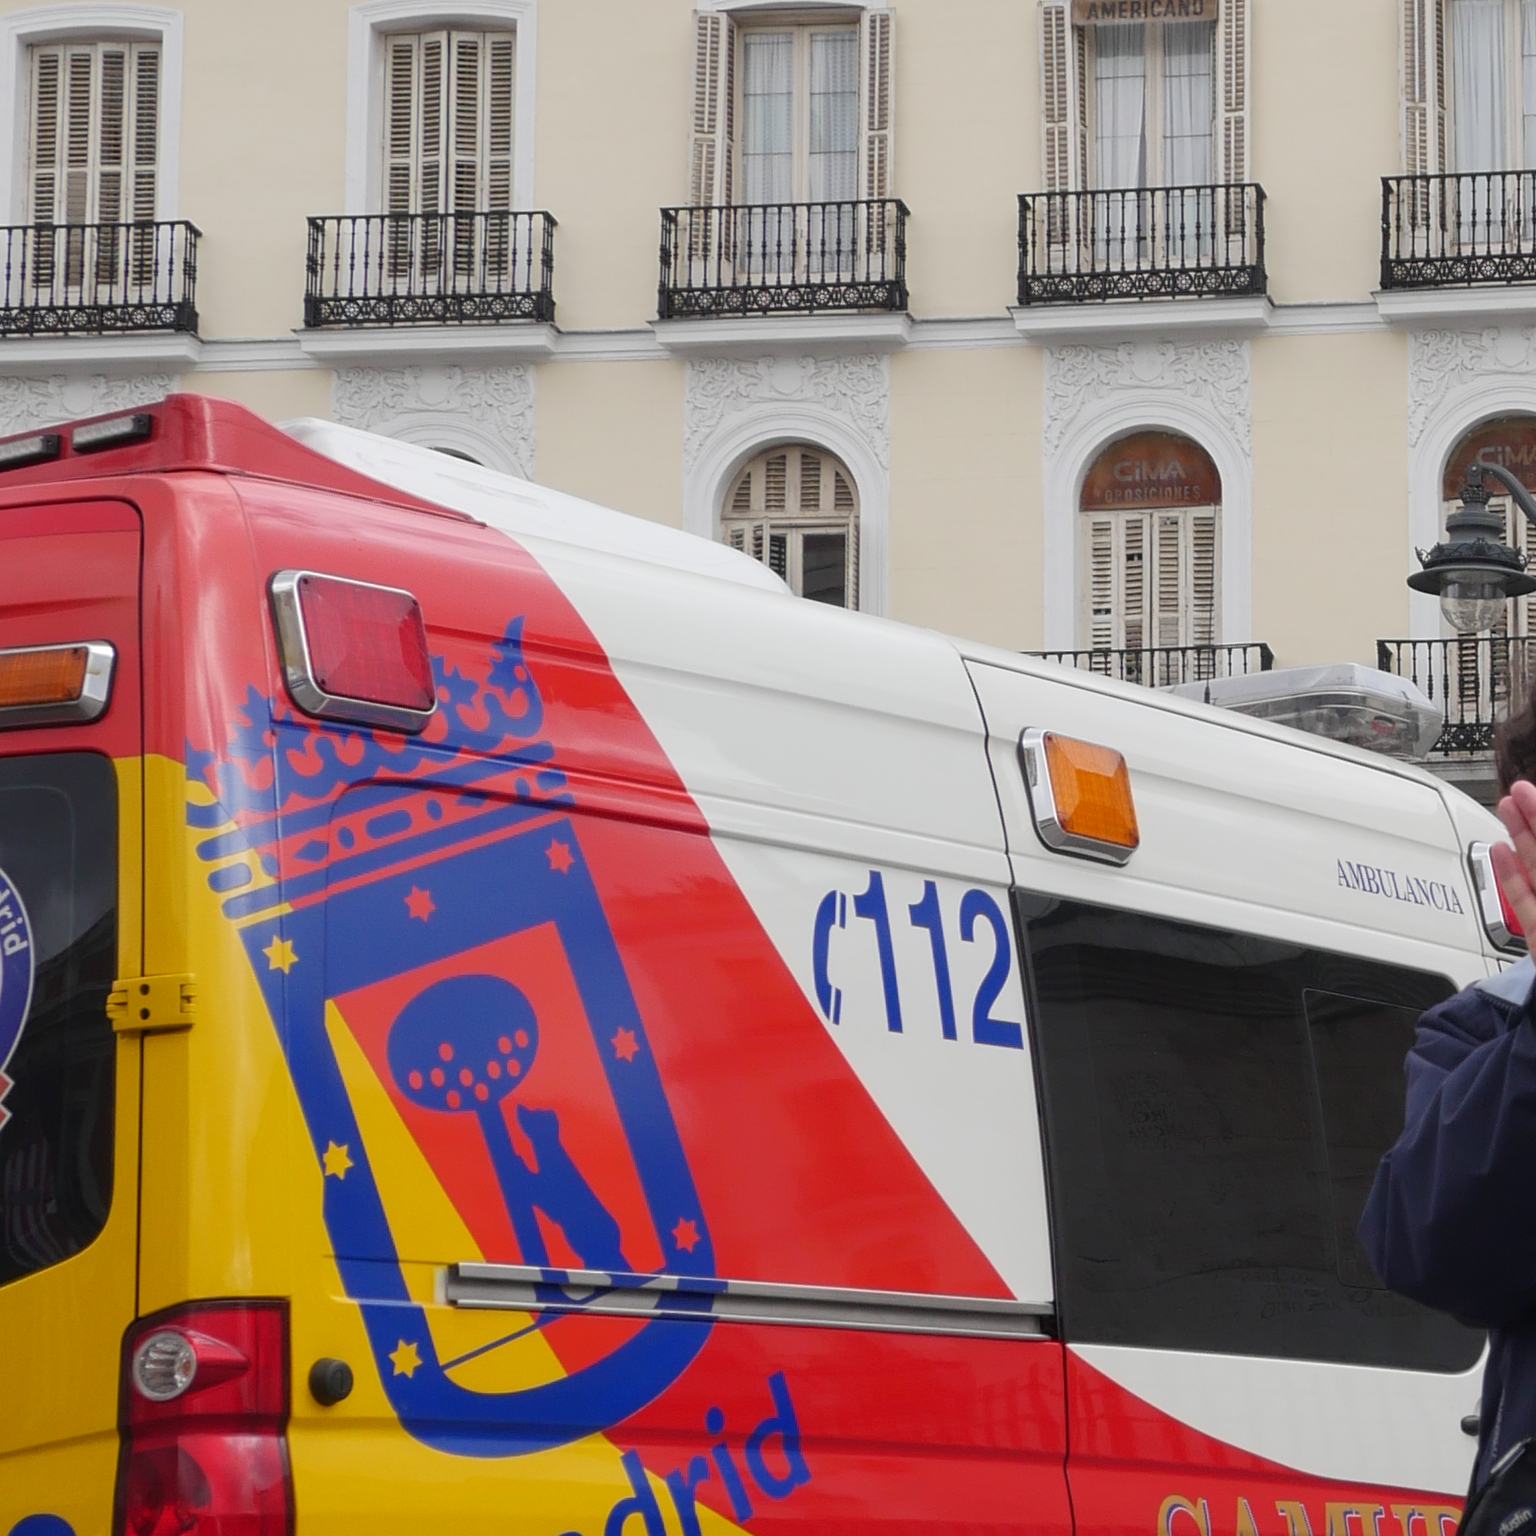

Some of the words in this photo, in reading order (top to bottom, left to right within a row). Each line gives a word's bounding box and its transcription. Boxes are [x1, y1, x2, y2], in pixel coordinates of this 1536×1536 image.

[1104, 485, 1201, 503] OPOSICIONES
[1337, 857, 1465, 915] AMBULANCIA
[853, 869, 1025, 1050] 112
